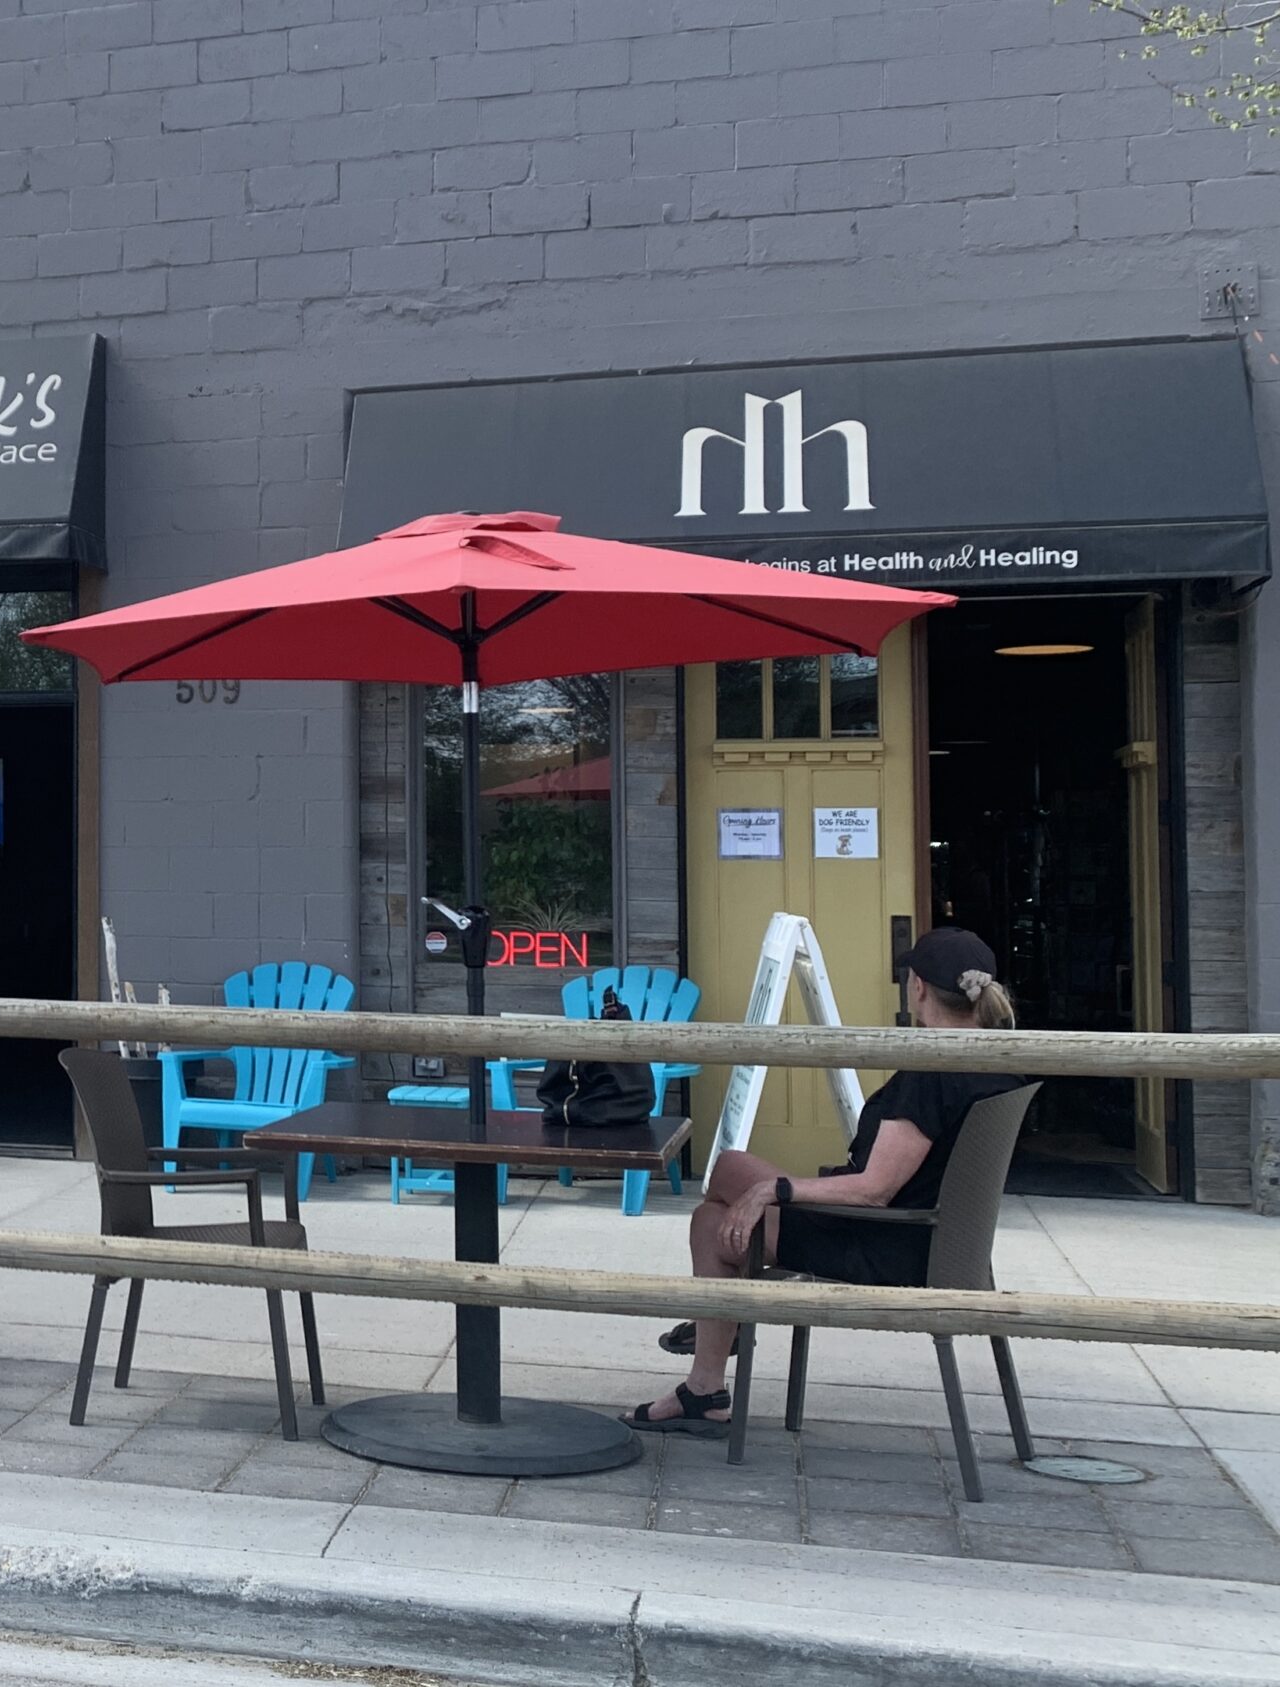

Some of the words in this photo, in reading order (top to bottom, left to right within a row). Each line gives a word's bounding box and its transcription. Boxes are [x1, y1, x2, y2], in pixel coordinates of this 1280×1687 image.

[817, 556, 837, 573] at
[843, 551, 924, 572] Health
[928, 544, 976, 571] and
[979, 546, 1079, 568] Healing
[175, 679, 241, 704] 509
[819, 818, 834, 826] DOG
[835, 818, 871, 826] FRIENDLY
[831, 810, 843, 818] WE
[845, 810, 858, 818] ARE
[486, 930, 587, 967] OPEN
